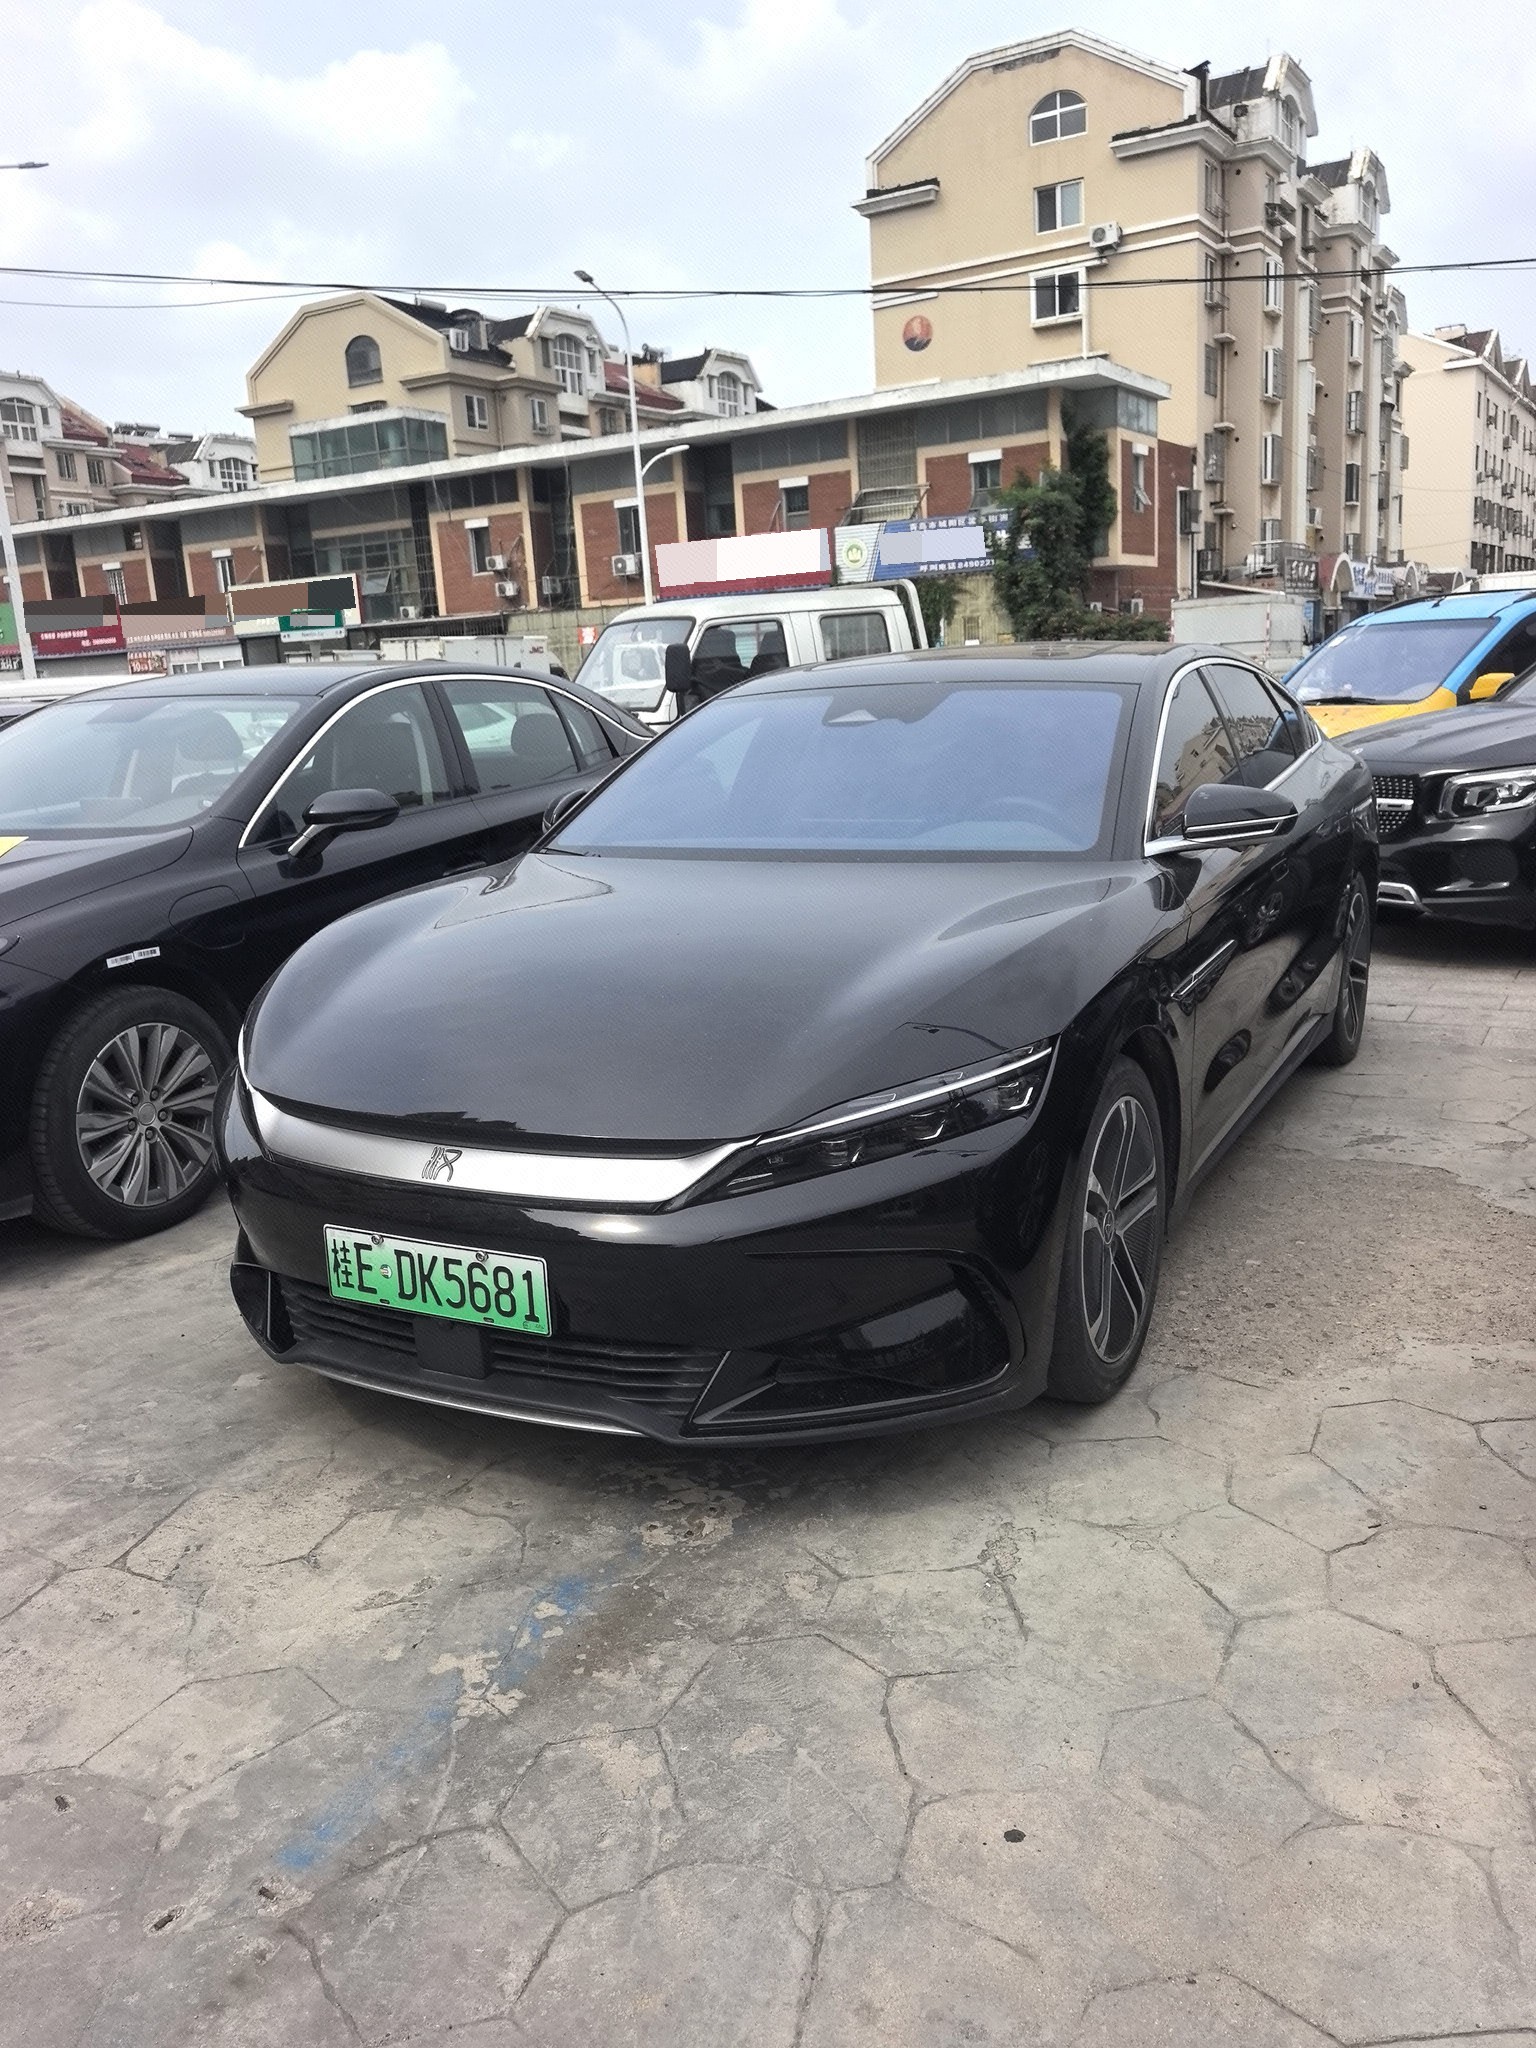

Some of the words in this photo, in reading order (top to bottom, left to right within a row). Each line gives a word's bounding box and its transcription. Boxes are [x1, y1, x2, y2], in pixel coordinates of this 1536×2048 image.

[529, 646, 544, 654] JMC
[331, 1238, 377, 1295] 桂E
[393, 1248, 540, 1323] DK5681
